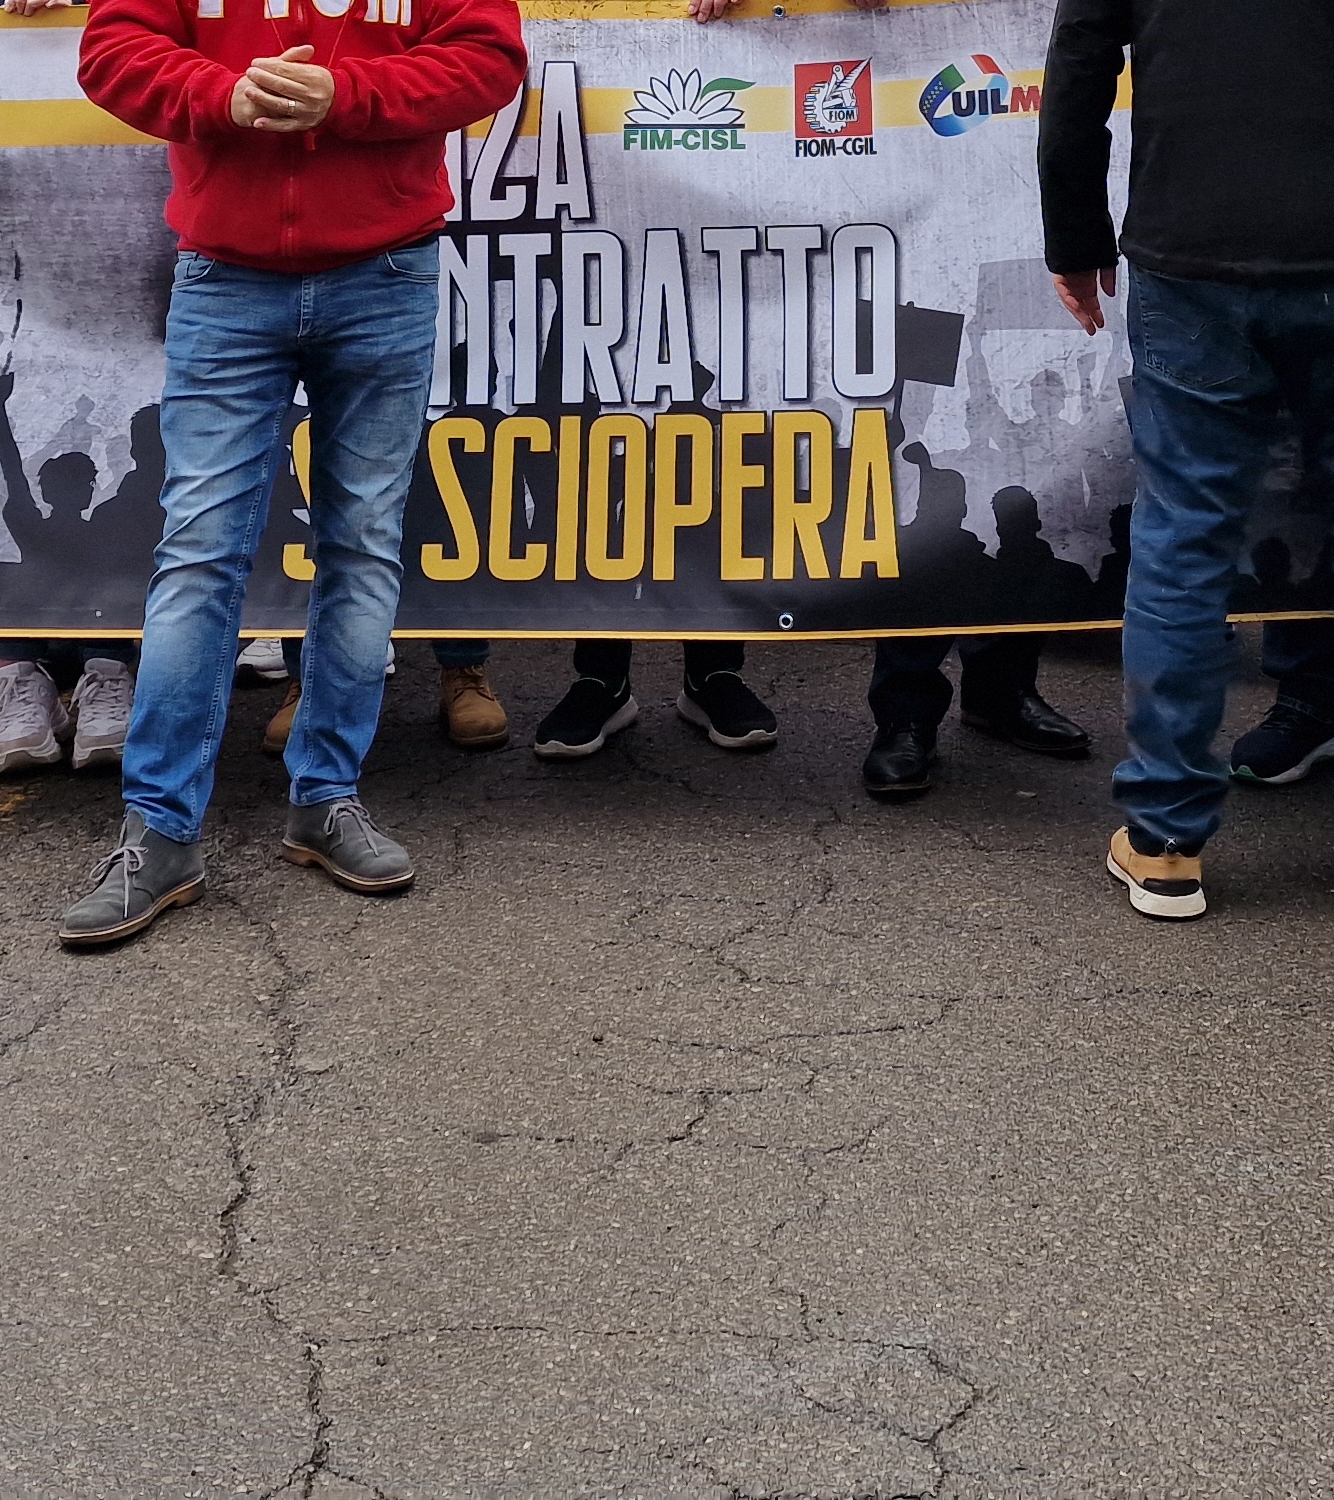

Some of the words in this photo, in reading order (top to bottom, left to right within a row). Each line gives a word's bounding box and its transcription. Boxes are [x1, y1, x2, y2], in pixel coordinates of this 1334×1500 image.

[951, 85, 1043, 118] UILM
[828, 108, 856, 123] FIOM
[623, 129, 747, 150] FIM-CISL
[794, 136, 878, 158] FIOM-CGIL
[427, 222, 898, 409] NTRATTO
[419, 408, 900, 582] SCIOPERA
